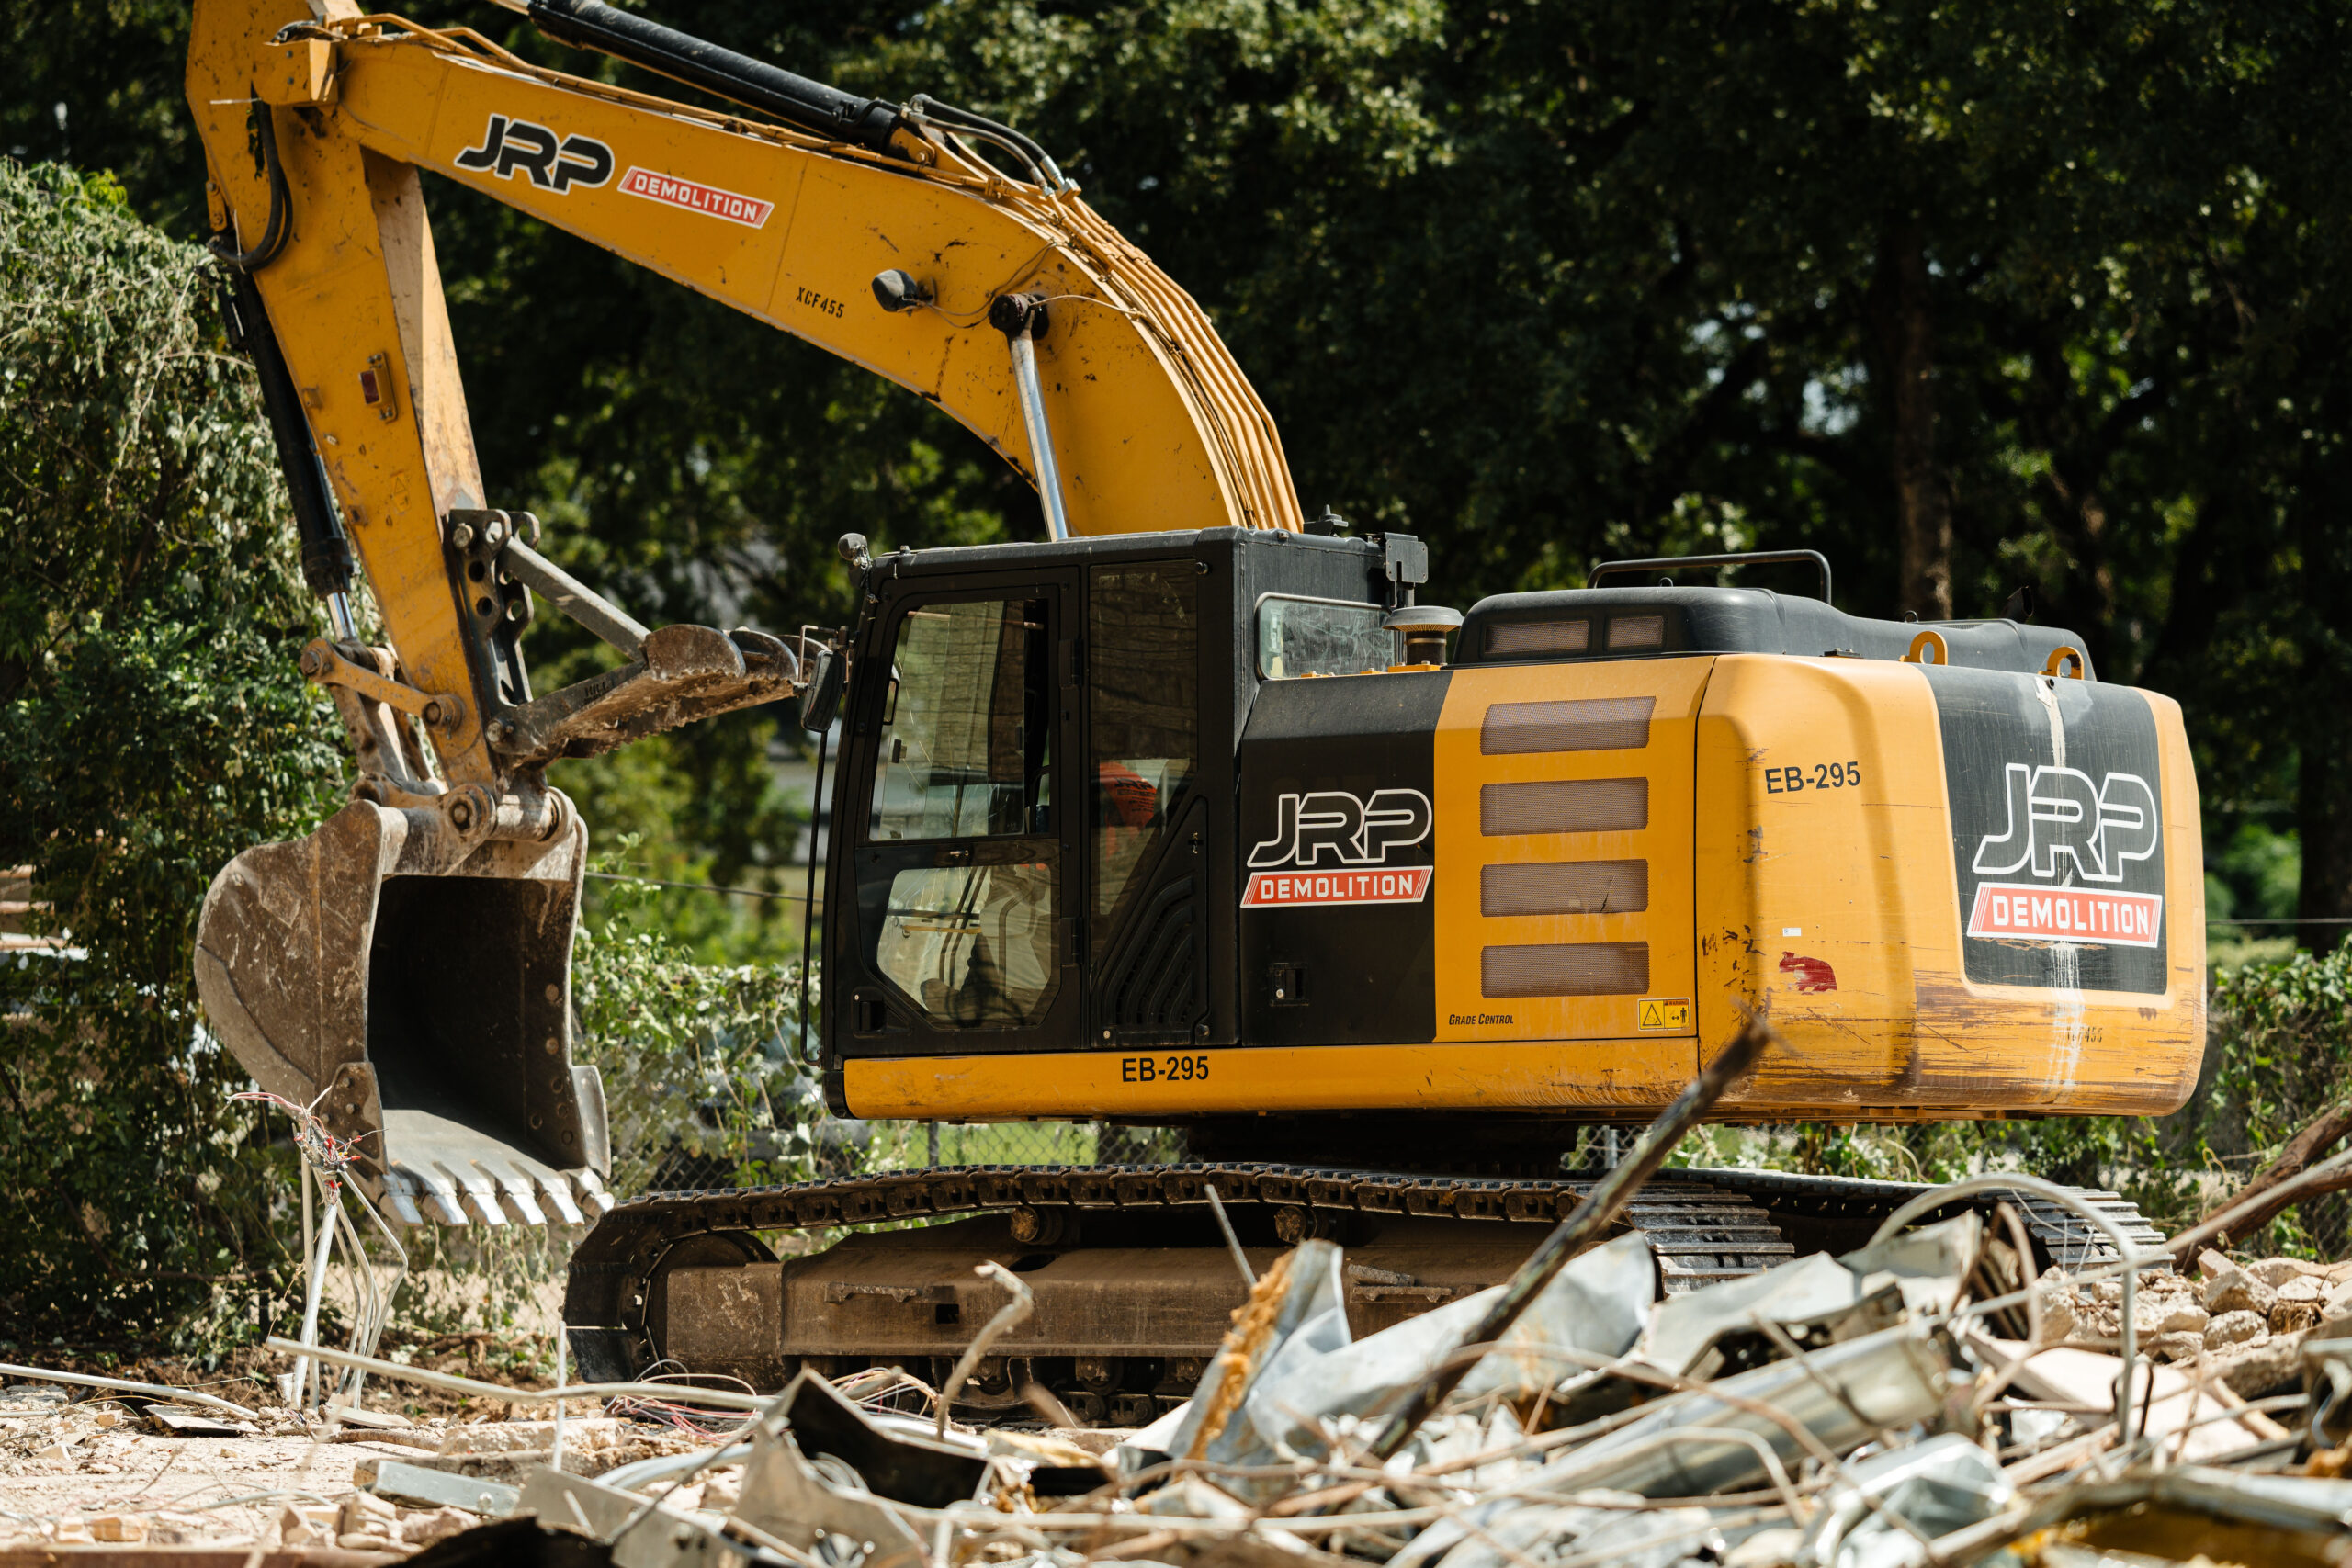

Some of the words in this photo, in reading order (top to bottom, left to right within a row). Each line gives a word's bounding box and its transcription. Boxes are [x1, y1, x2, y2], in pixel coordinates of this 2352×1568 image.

[454, 113, 615, 196] JRP
[634, 174, 758, 222] DEMOLITION
[796, 286, 845, 318] XCF455
[1765, 761, 1861, 795] EB-295
[1247, 788, 1432, 868] JRP
[1972, 762, 2157, 882] JRP
[1261, 874, 1413, 900] DEMOLITION
[1992, 894, 2150, 936] DEMOLITION
[1122, 1055, 1209, 1082] EB-295
